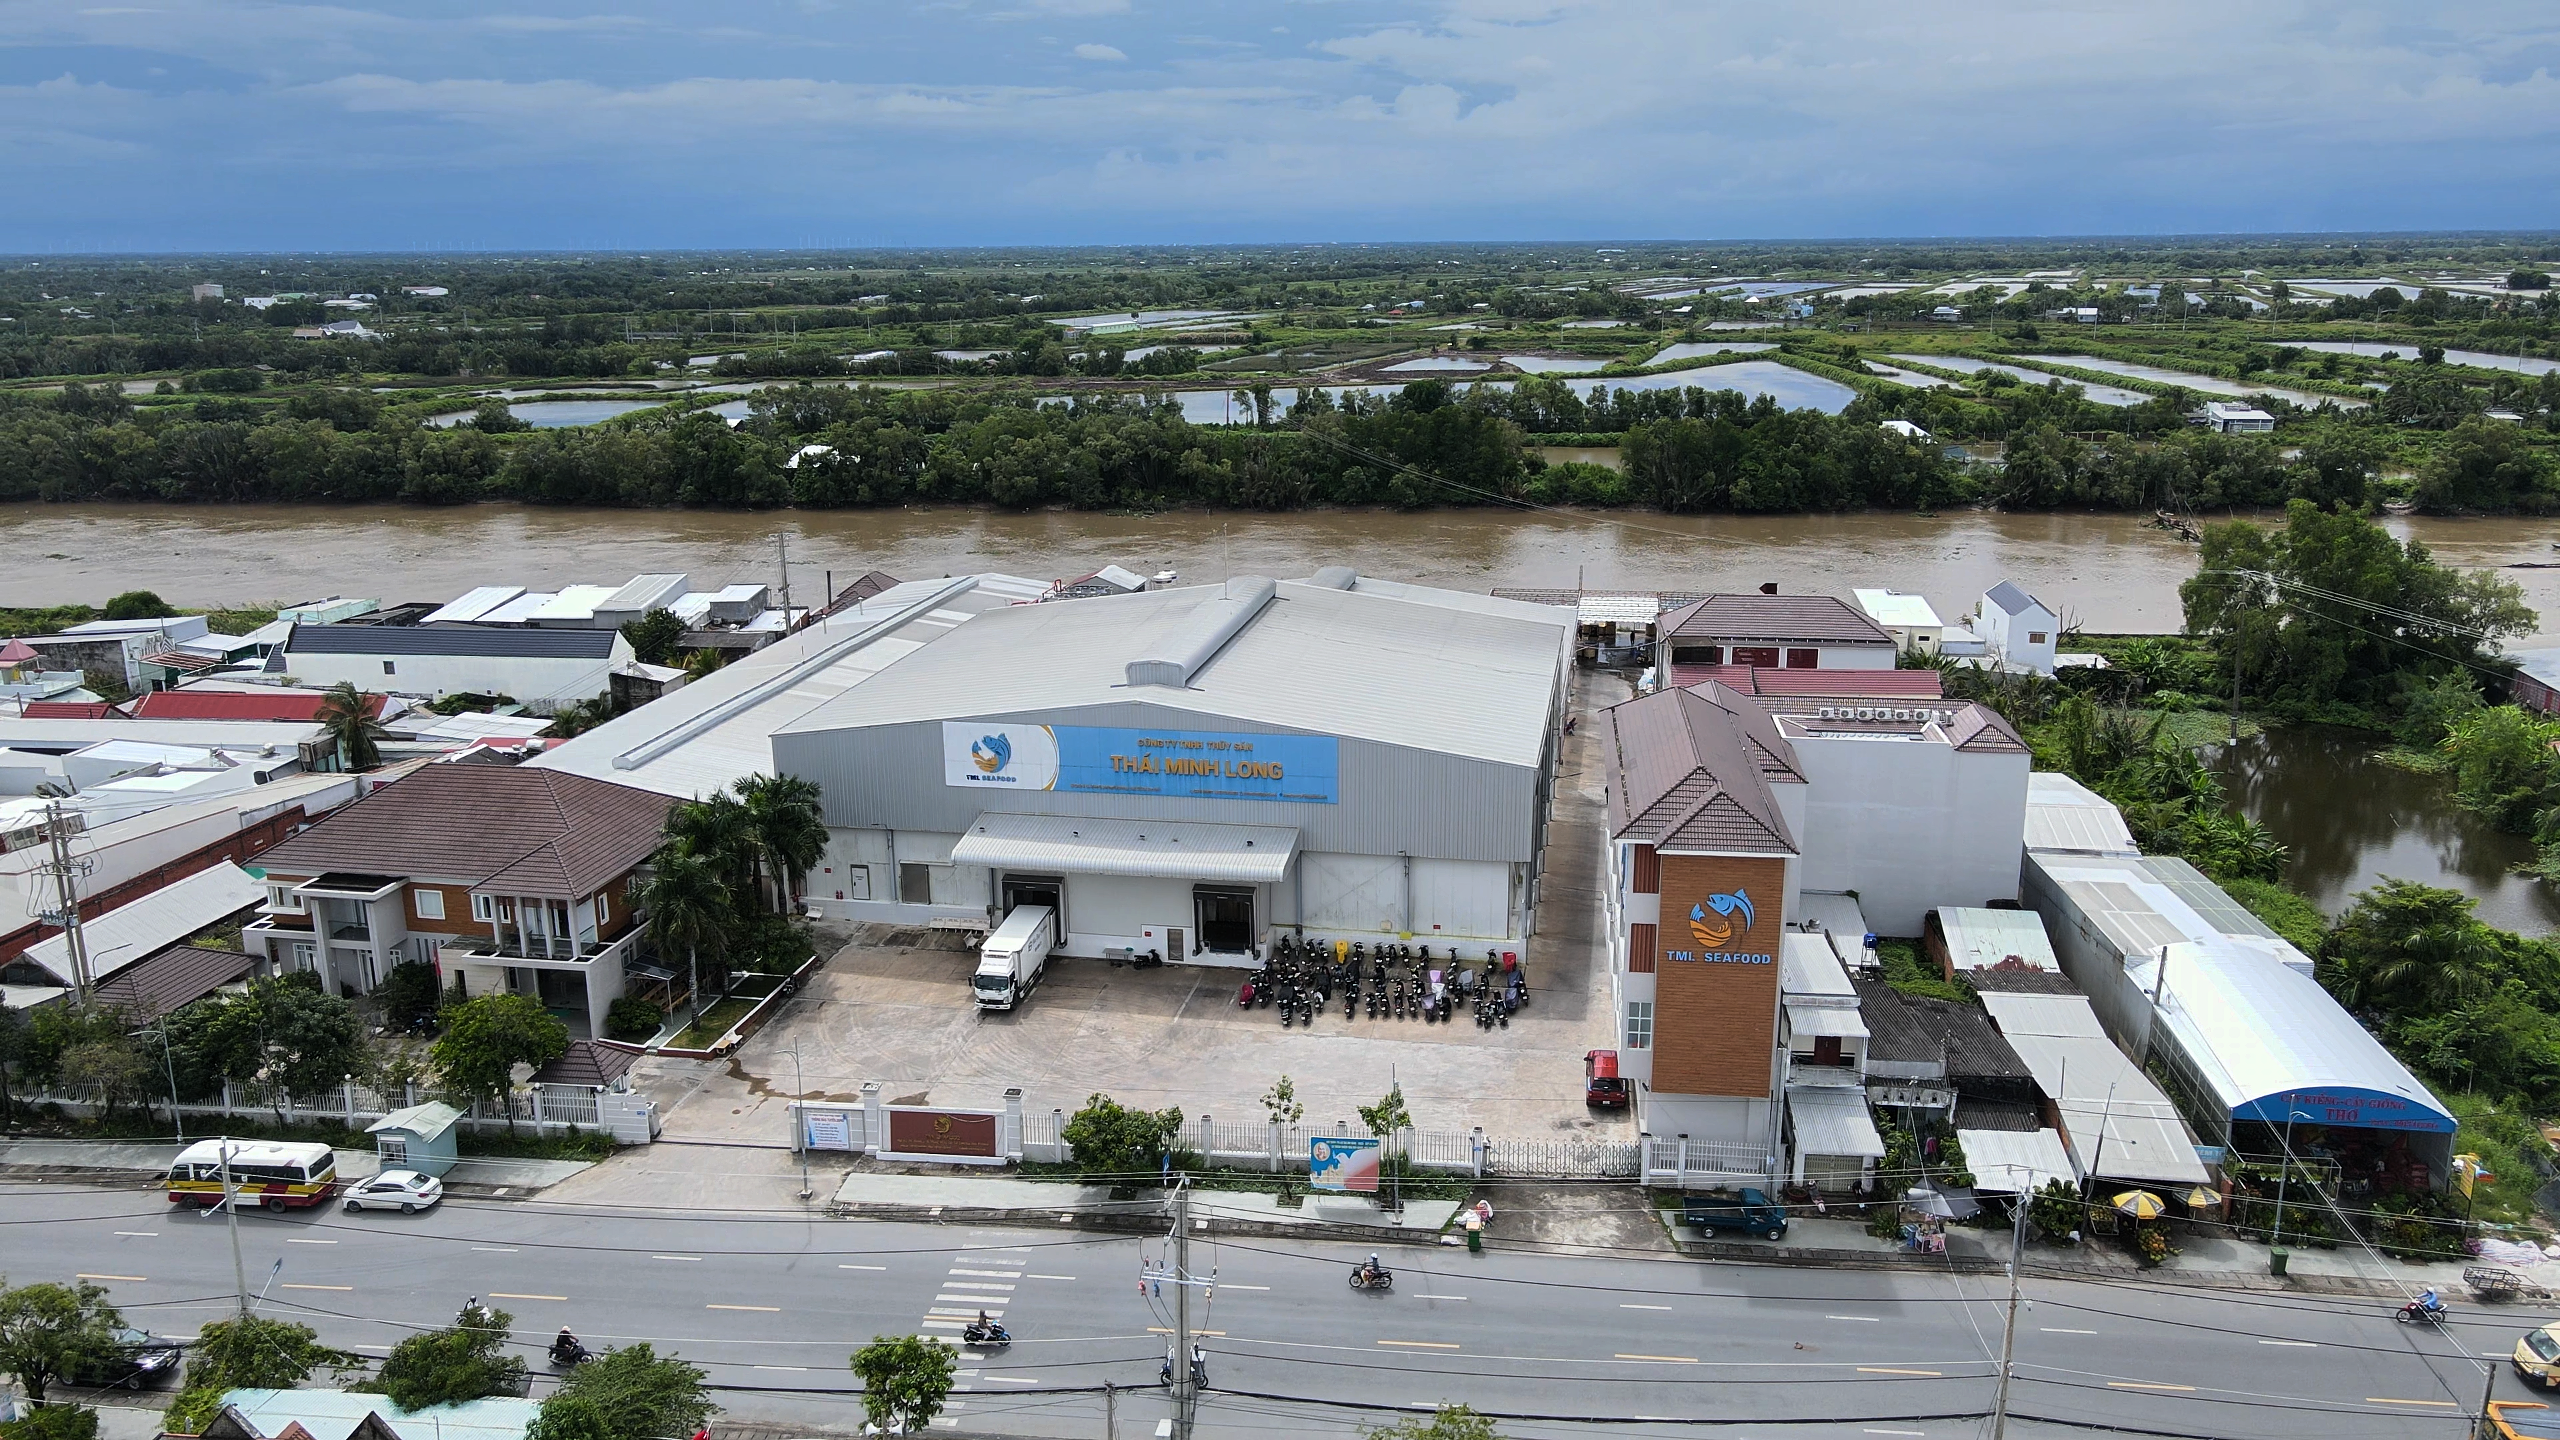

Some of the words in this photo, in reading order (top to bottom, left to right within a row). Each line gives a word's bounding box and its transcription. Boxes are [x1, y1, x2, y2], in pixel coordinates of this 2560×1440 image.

[1138, 737, 1164, 748] CÔNG
[1165, 739, 1178, 749] TY
[1180, 740, 1204, 750] TNHH
[1110, 752, 1160, 775] THÁI
[1165, 756, 1219, 777] MINH
[1225, 760, 1283, 780] LONG
[982, 775, 1017, 783] SEAFOOD
[1666, 950, 1696, 962] TML
[1704, 952, 1772, 965] SEAFOOD
